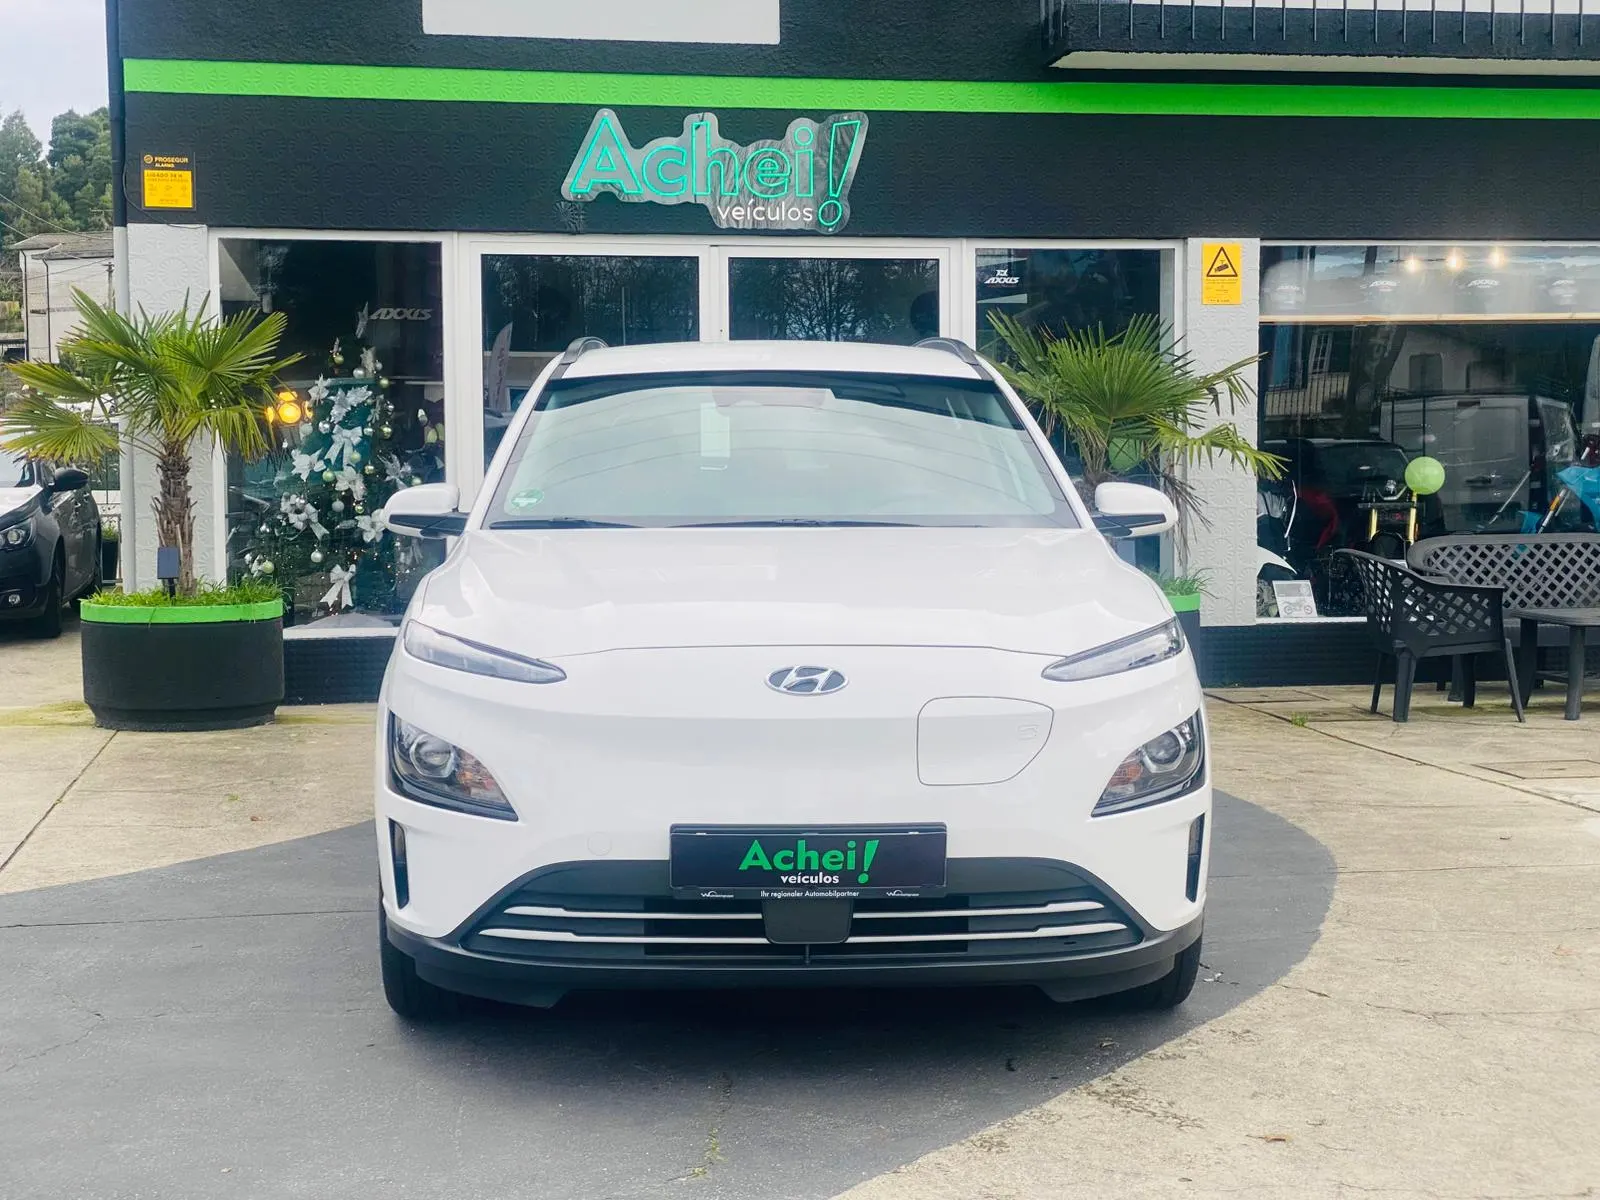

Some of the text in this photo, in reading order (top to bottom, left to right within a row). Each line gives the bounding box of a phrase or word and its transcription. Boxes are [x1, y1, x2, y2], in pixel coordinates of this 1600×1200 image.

[569, 116, 862, 227] Achei!
[716, 200, 813, 222] veículos
[738, 839, 880, 884] Achei!
[780, 871, 840, 885] veículos
[771, 890, 803, 899] regionaler
[805, 890, 860, 898] Automobilpartner
